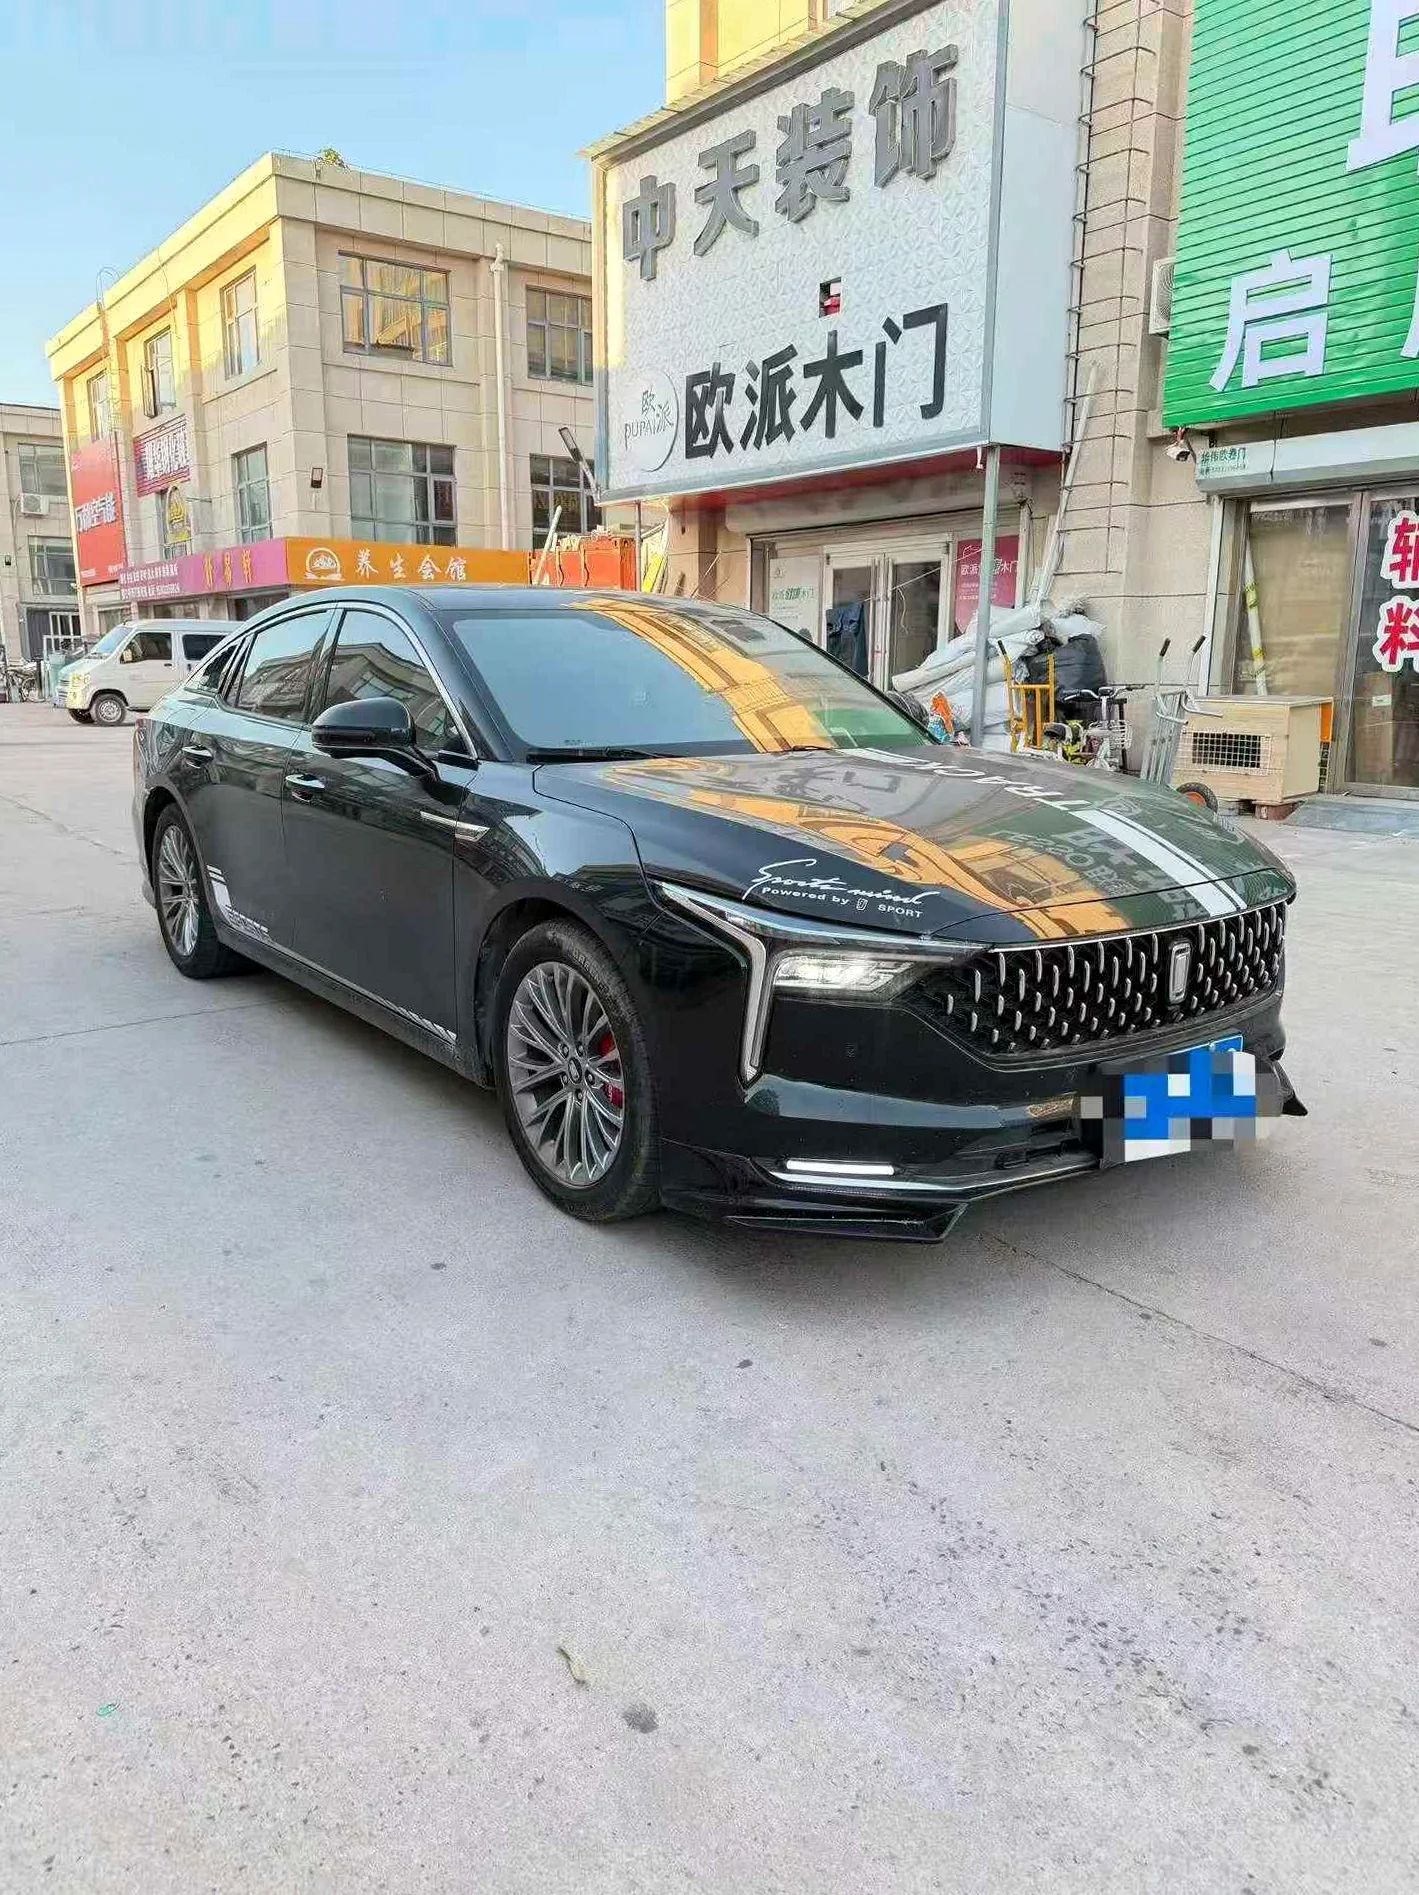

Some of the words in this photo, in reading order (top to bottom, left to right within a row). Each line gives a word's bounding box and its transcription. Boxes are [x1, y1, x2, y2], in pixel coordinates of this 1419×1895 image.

[623, 43, 958, 281] 中天装饰
[685, 303, 948, 459] 欧派木门
[355, 548, 467, 582] 养生会馆
[762, 887, 826, 901] Powered
[832, 895, 850, 906] by
[878, 903, 924, 919] SPORT
